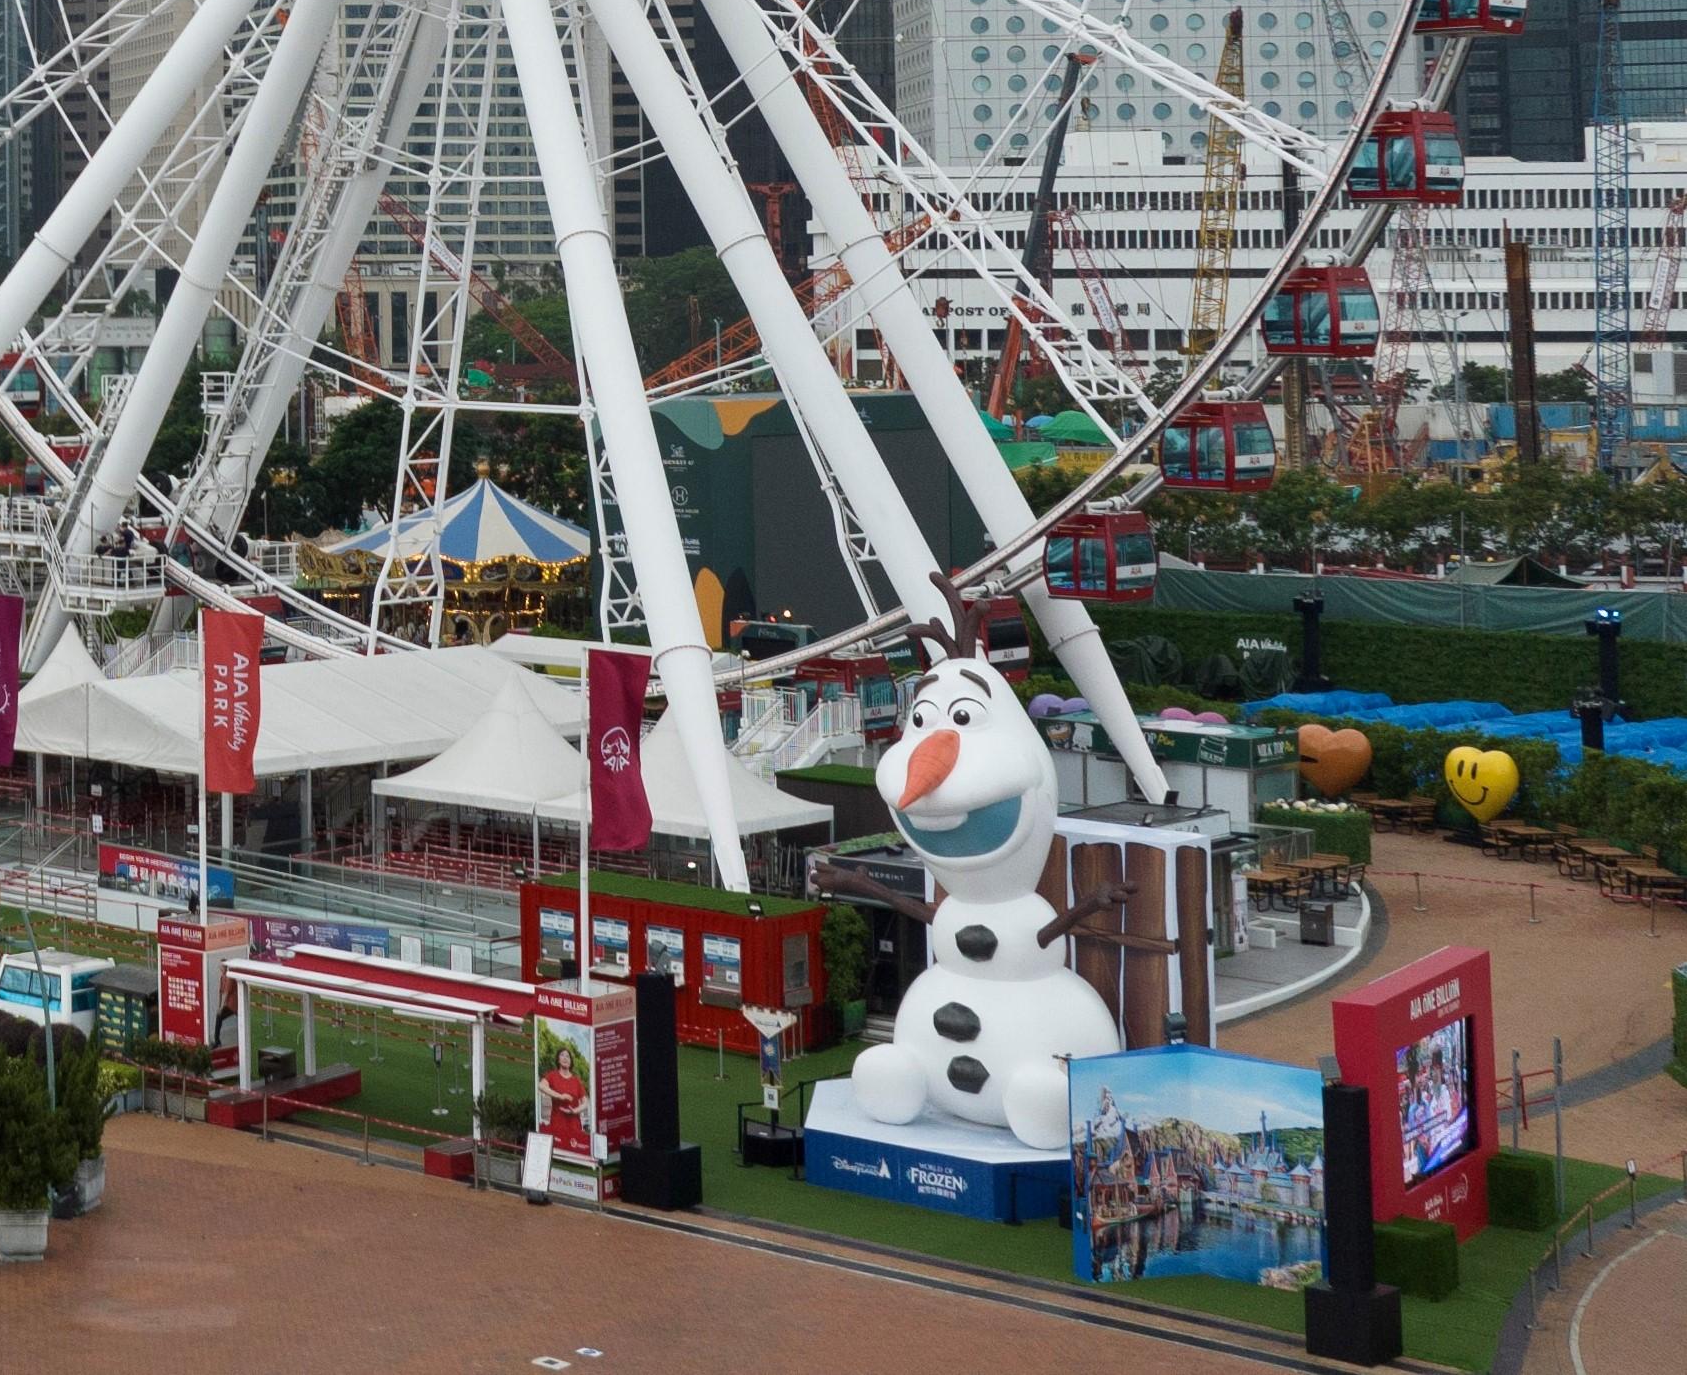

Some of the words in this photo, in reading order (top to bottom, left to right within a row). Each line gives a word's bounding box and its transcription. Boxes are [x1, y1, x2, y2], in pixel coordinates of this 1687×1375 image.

[949, 306, 984, 316] POST
[1071, 303, 1150, 316] 郵總局
[1236, 637, 1260, 650] AIA
[233, 652, 250, 698] AIA
[213, 664, 229, 728] PARK
[870, 707, 882, 717] AIA
[227, 701, 251, 752] Vitality
[603, 755, 630, 772] AIA
[537, 993, 549, 1005] AIA
[909, 1167, 964, 1193] FROZEN
